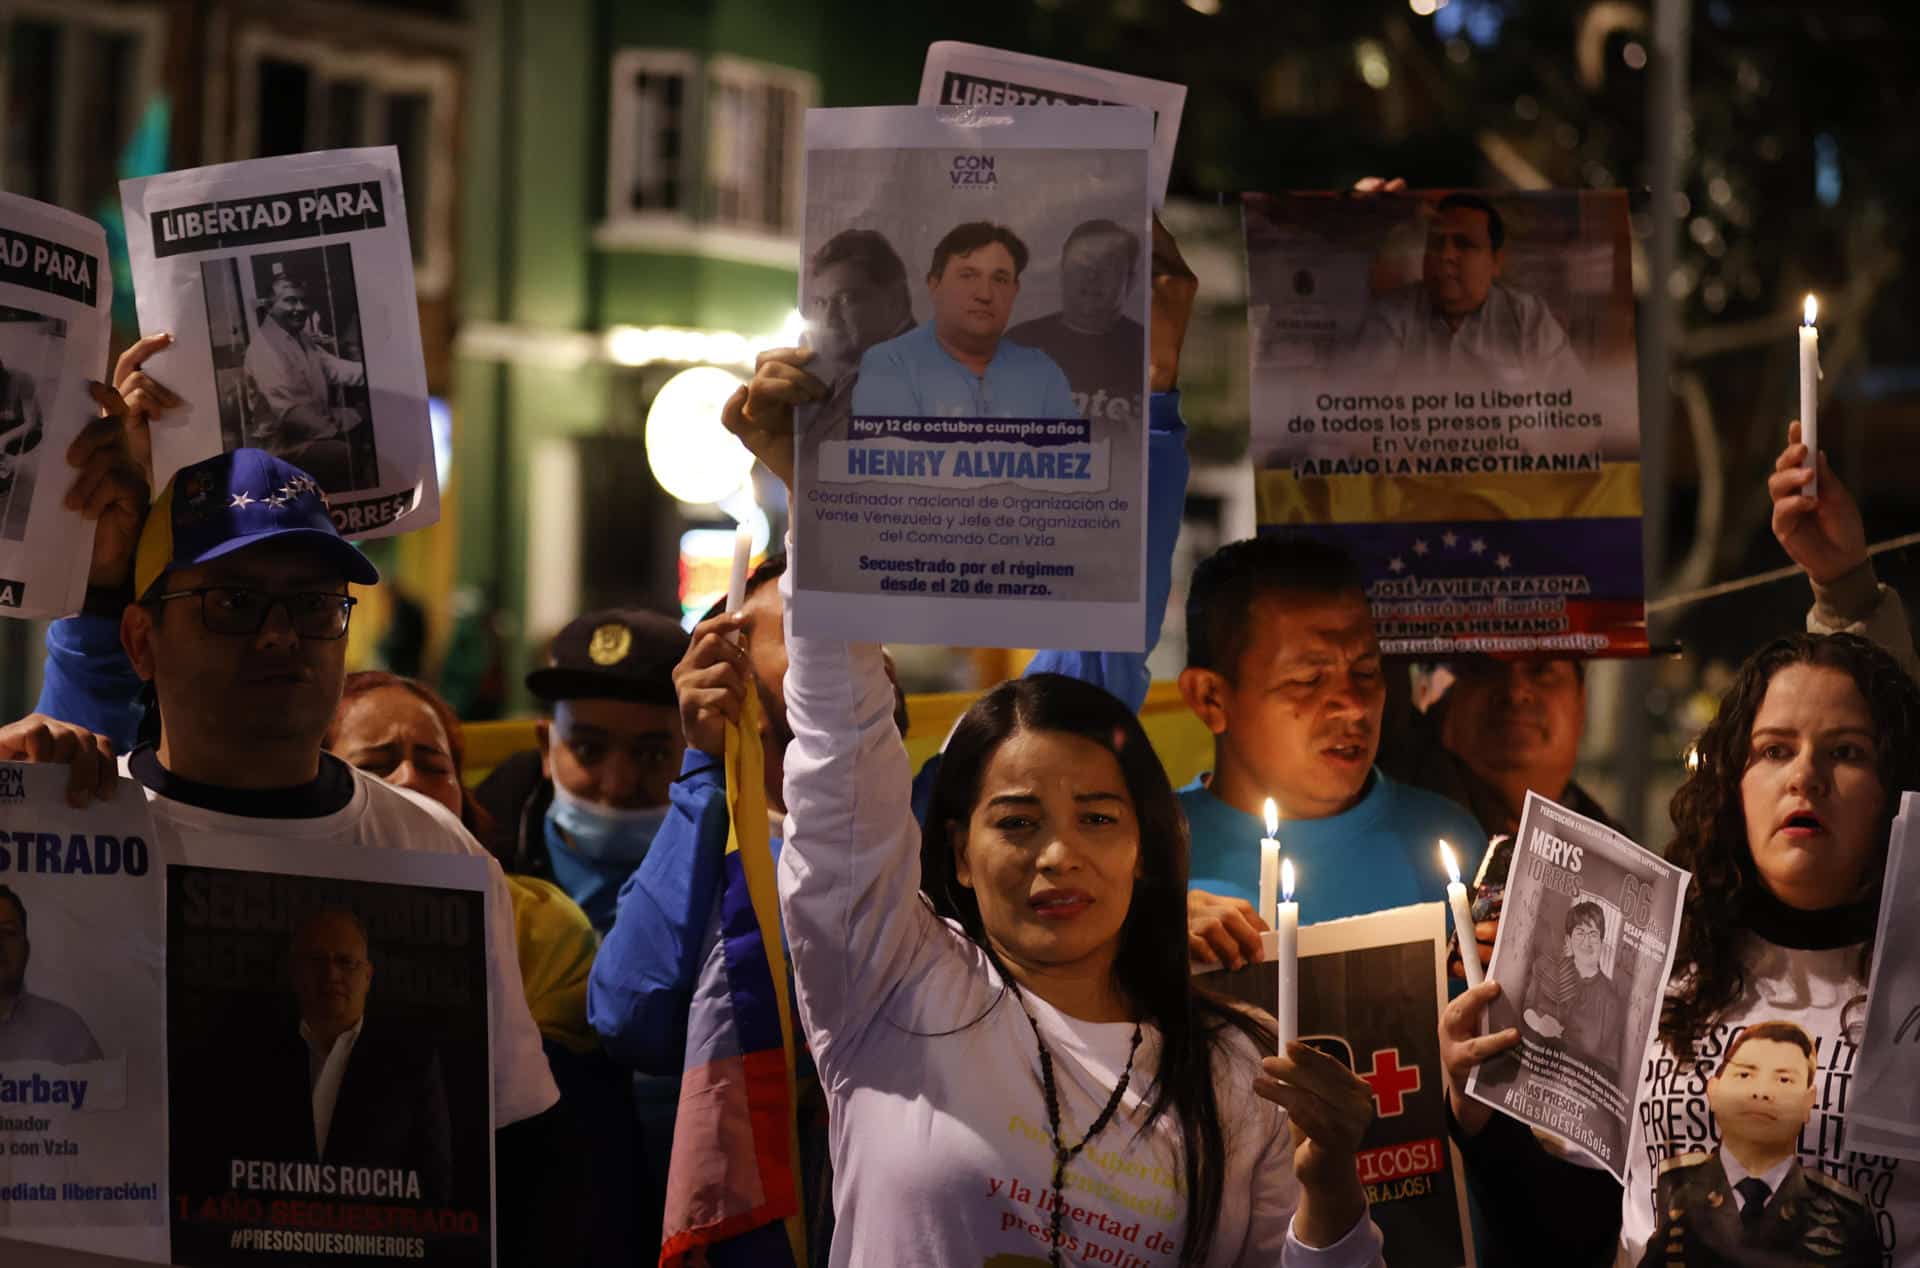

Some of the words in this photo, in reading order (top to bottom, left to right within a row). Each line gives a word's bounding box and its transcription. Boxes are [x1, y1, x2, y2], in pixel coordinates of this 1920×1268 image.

[950, 79, 1080, 105] LIBER
[954, 155, 994, 170] CON
[950, 171, 999, 185] VZLA
[162, 200, 292, 241] LIBERTAD
[298, 189, 378, 223] PARA
[33, 244, 91, 289] PARA
[1316, 394, 1404, 411] Oramos
[1411, 391, 1448, 415] por
[1454, 391, 1475, 408] la
[1481, 388, 1573, 408] Libertad
[854, 420, 882, 436] Hoy
[887, 420, 901, 432] 12
[903, 420, 921, 433] de
[924, 420, 983, 434] octubre
[986, 422, 1044, 437] cumple
[1047, 422, 1084, 436] años
[1288, 416, 1316, 434] de
[1321, 415, 1384, 433] todos
[1391, 414, 1421, 432] los
[1428, 414, 1503, 434] presos
[1373, 436, 1398, 453] En
[1405, 434, 1520, 453] Venezuela
[848, 448, 945, 476] HENRY
[953, 451, 1091, 479] ALVIAREZ
[1385, 458, 1412, 474] LA
[808, 489, 904, 507] Coordinador
[909, 494, 975, 509] nacional
[981, 494, 1000, 509] de
[1110, 497, 1129, 511] de
[816, 509, 859, 523] Vente
[864, 510, 942, 526] Venezuela
[946, 515, 954, 528] y
[960, 514, 992, 528] Jefe
[996, 516, 1015, 529] de
[880, 530, 903, 543] del
[908, 531, 984, 545] Comando
[989, 534, 1020, 547] Con
[860, 555, 956, 573] Secuestrado
[960, 560, 986, 577] por
[992, 559, 1005, 573] el
[880, 575, 926, 591] desde
[932, 576, 946, 592] el
[950, 577, 970, 593] 20
[975, 577, 994, 594] de
[999, 581, 1052, 595] marzo.
[1529, 826, 1584, 873] MERYS
[10, 1142, 39, 1155] con
[1356, 1143, 1437, 1181] ICOS!
[231, 1159, 337, 1194] PERKINS
[340, 1166, 421, 1200] ROCHA
[985, 1176, 1003, 1199] y
[1008, 1177, 1032, 1204] la
[1037, 1189, 1141, 1243] libertad
[1144, 1231, 1175, 1256] de
[1000, 1211, 1078, 1252] presos
[230, 1229, 425, 1259] #PRESOSQUESONHEROES
